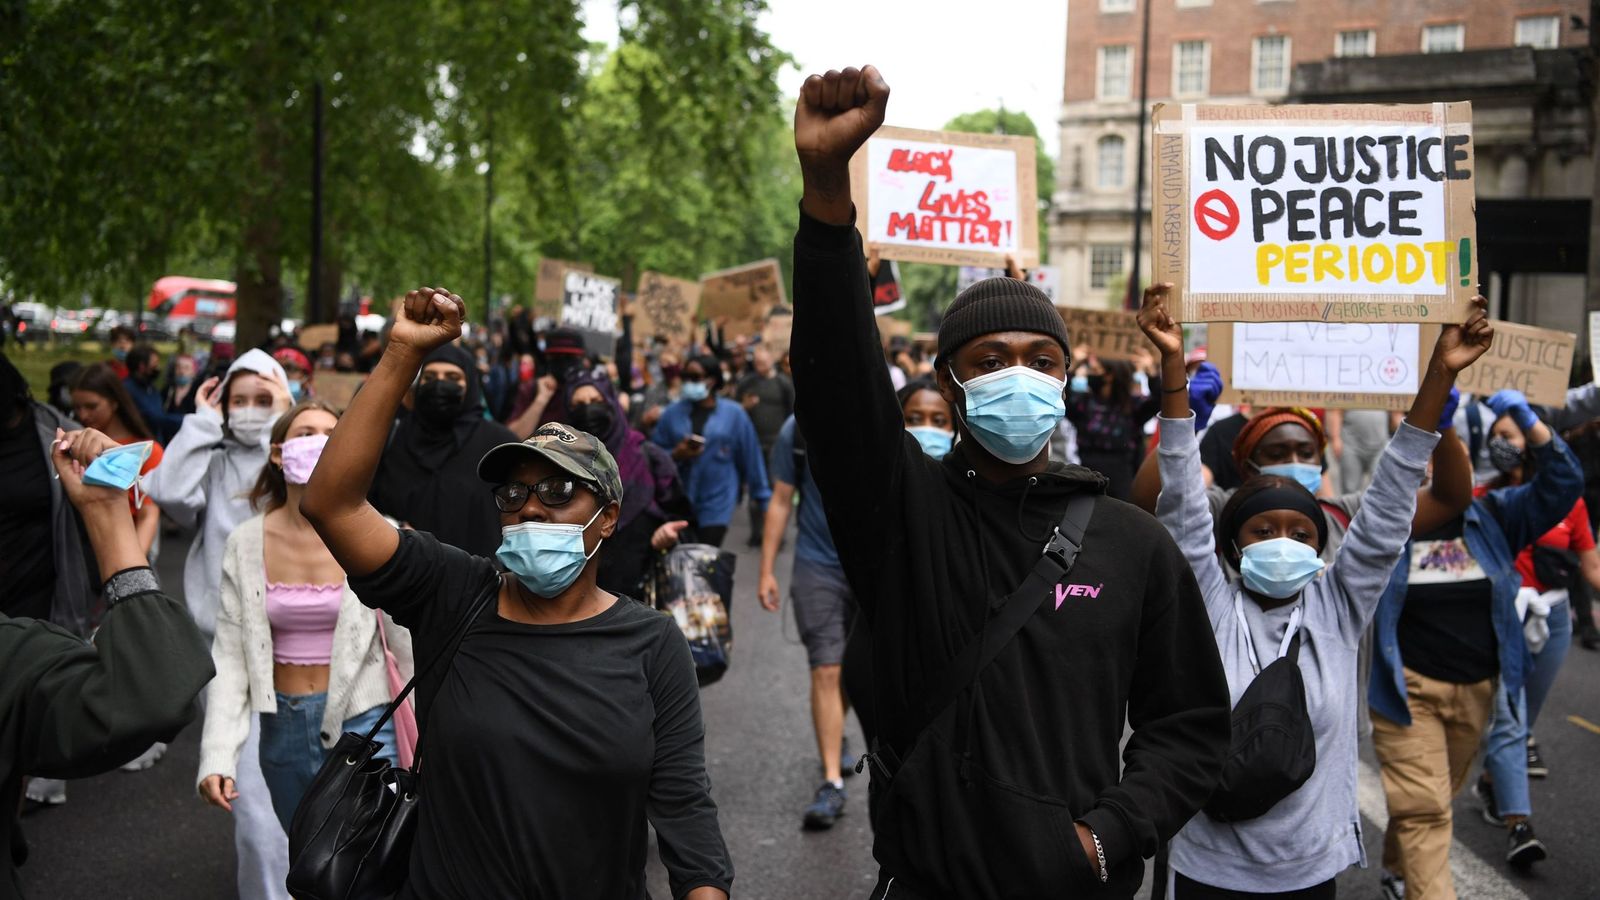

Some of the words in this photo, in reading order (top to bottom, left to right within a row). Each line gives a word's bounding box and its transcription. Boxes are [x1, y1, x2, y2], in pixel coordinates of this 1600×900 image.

[888, 148, 953, 182] BLACK
[1160, 135, 1182, 199] AHMAUD
[1205, 135, 1286, 184] NO
[1294, 135, 1471, 184] JUSTICE
[918, 181, 991, 222] LIVES
[1251, 187, 1422, 242] PEACE
[887, 212, 1011, 247] MATTER!
[1202, 302, 1244, 318] BELLY
[1252, 302, 1320, 319] MUJINGA
[1333, 302, 1386, 318] GEORGE
[1393, 302, 1428, 317] FLOYD
[1243, 351, 1376, 386] MATTER
[1486, 332, 1568, 370] JUSTICE
[1479, 361, 1539, 398] PEACE
[1051, 583, 1101, 611] VEN
